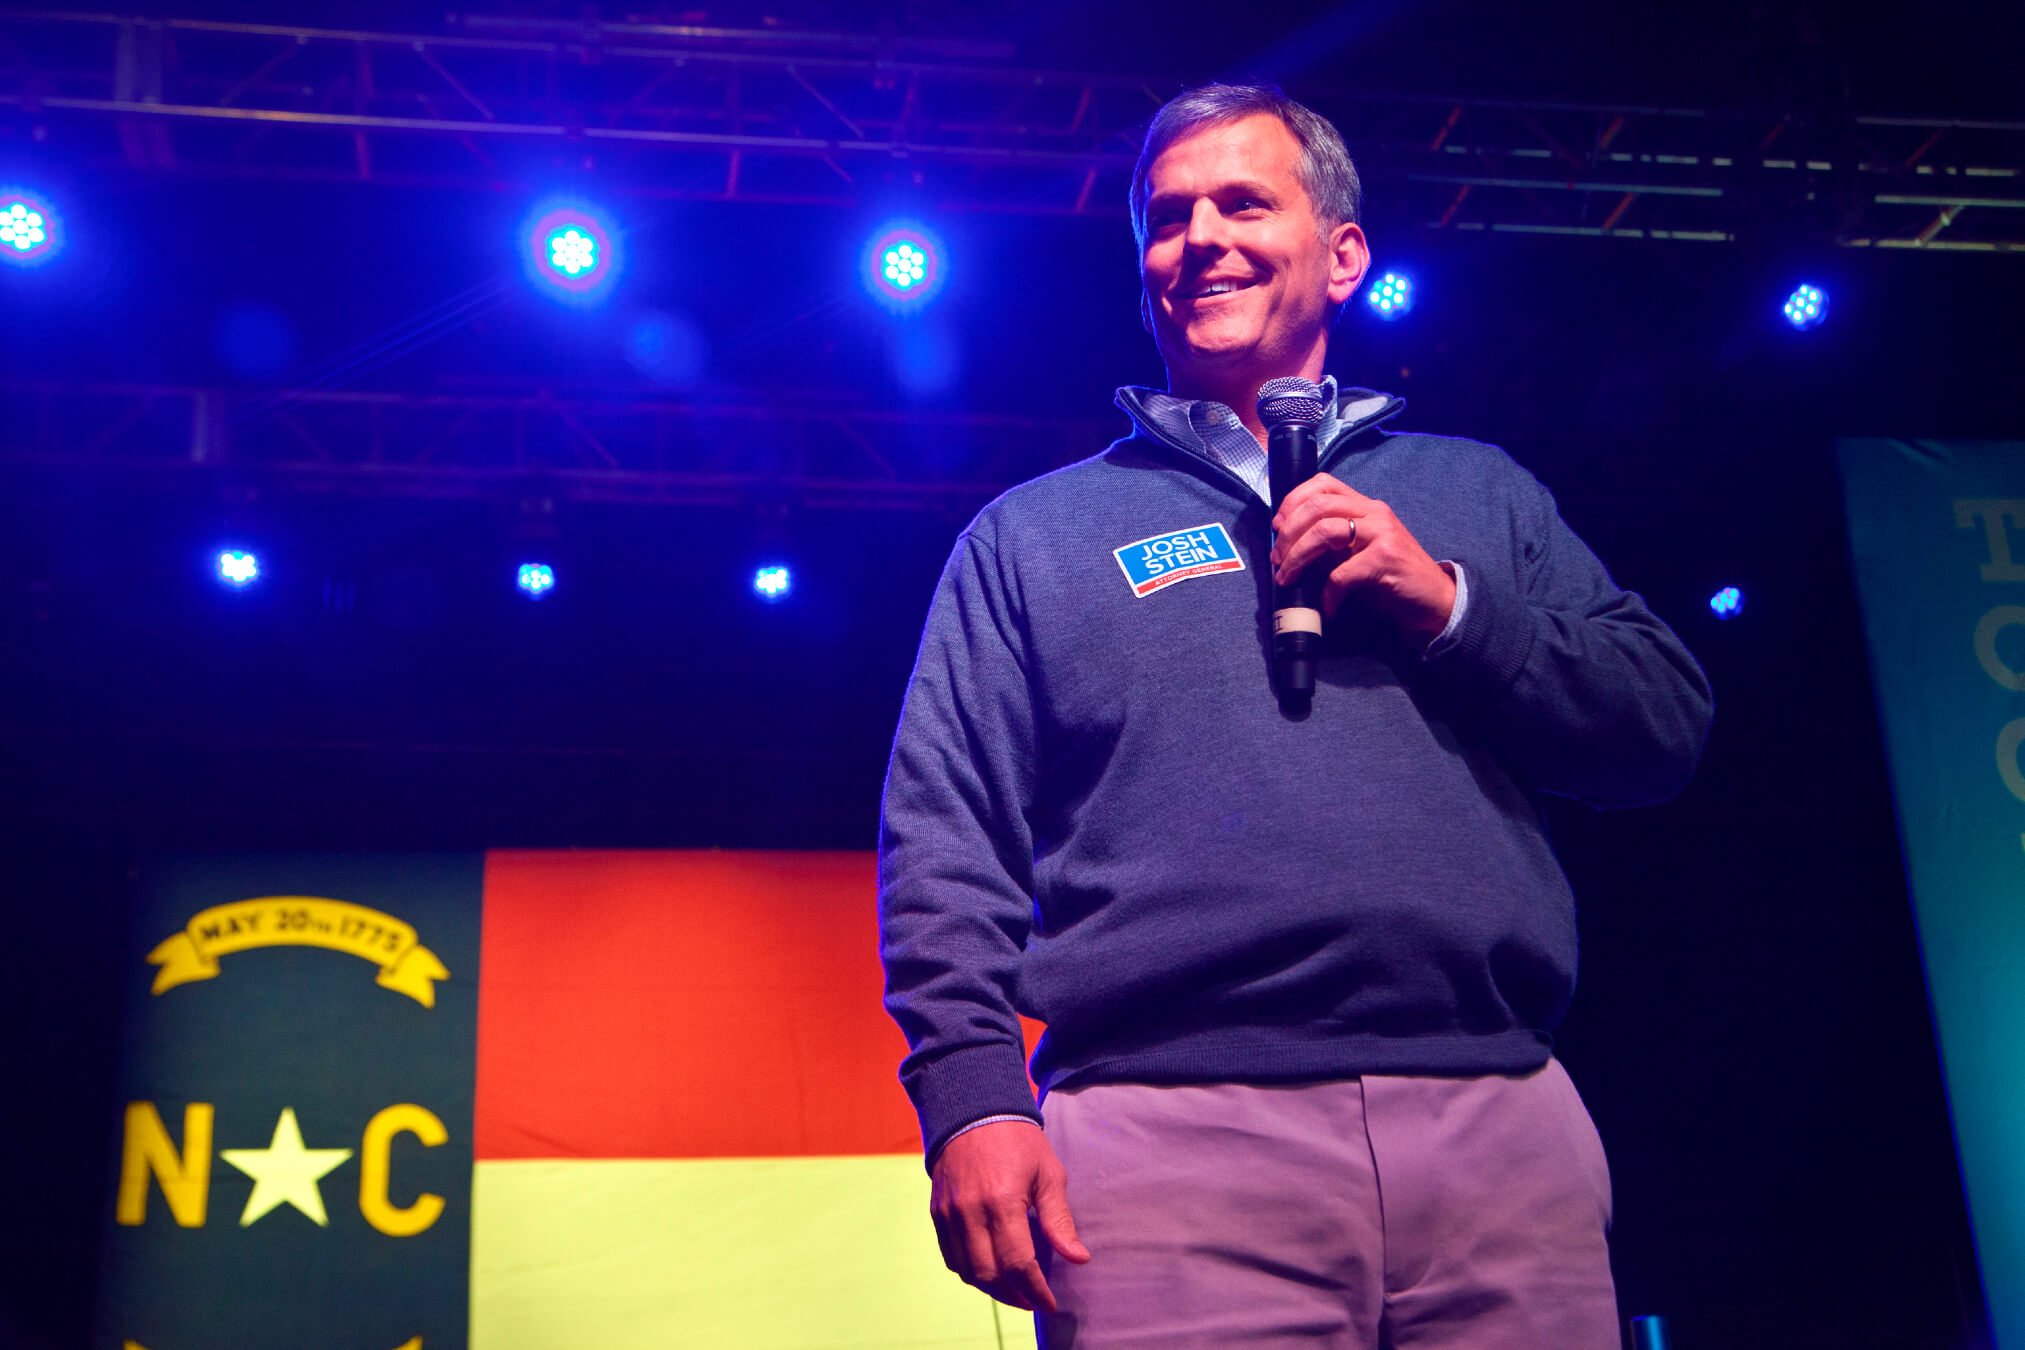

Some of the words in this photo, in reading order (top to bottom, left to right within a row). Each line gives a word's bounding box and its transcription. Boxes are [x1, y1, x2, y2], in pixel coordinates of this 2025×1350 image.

[1142, 532, 1210, 560] JOSH
[1145, 545, 1218, 574] STEIN
[1155, 570, 1190, 586] ATTORNEY
[1192, 564, 1223, 574] GENERAL
[201, 914, 262, 940] MAY
[340, 917, 401, 951] 1775
[116, 1101, 214, 1227] N
[359, 1103, 448, 1236] C
